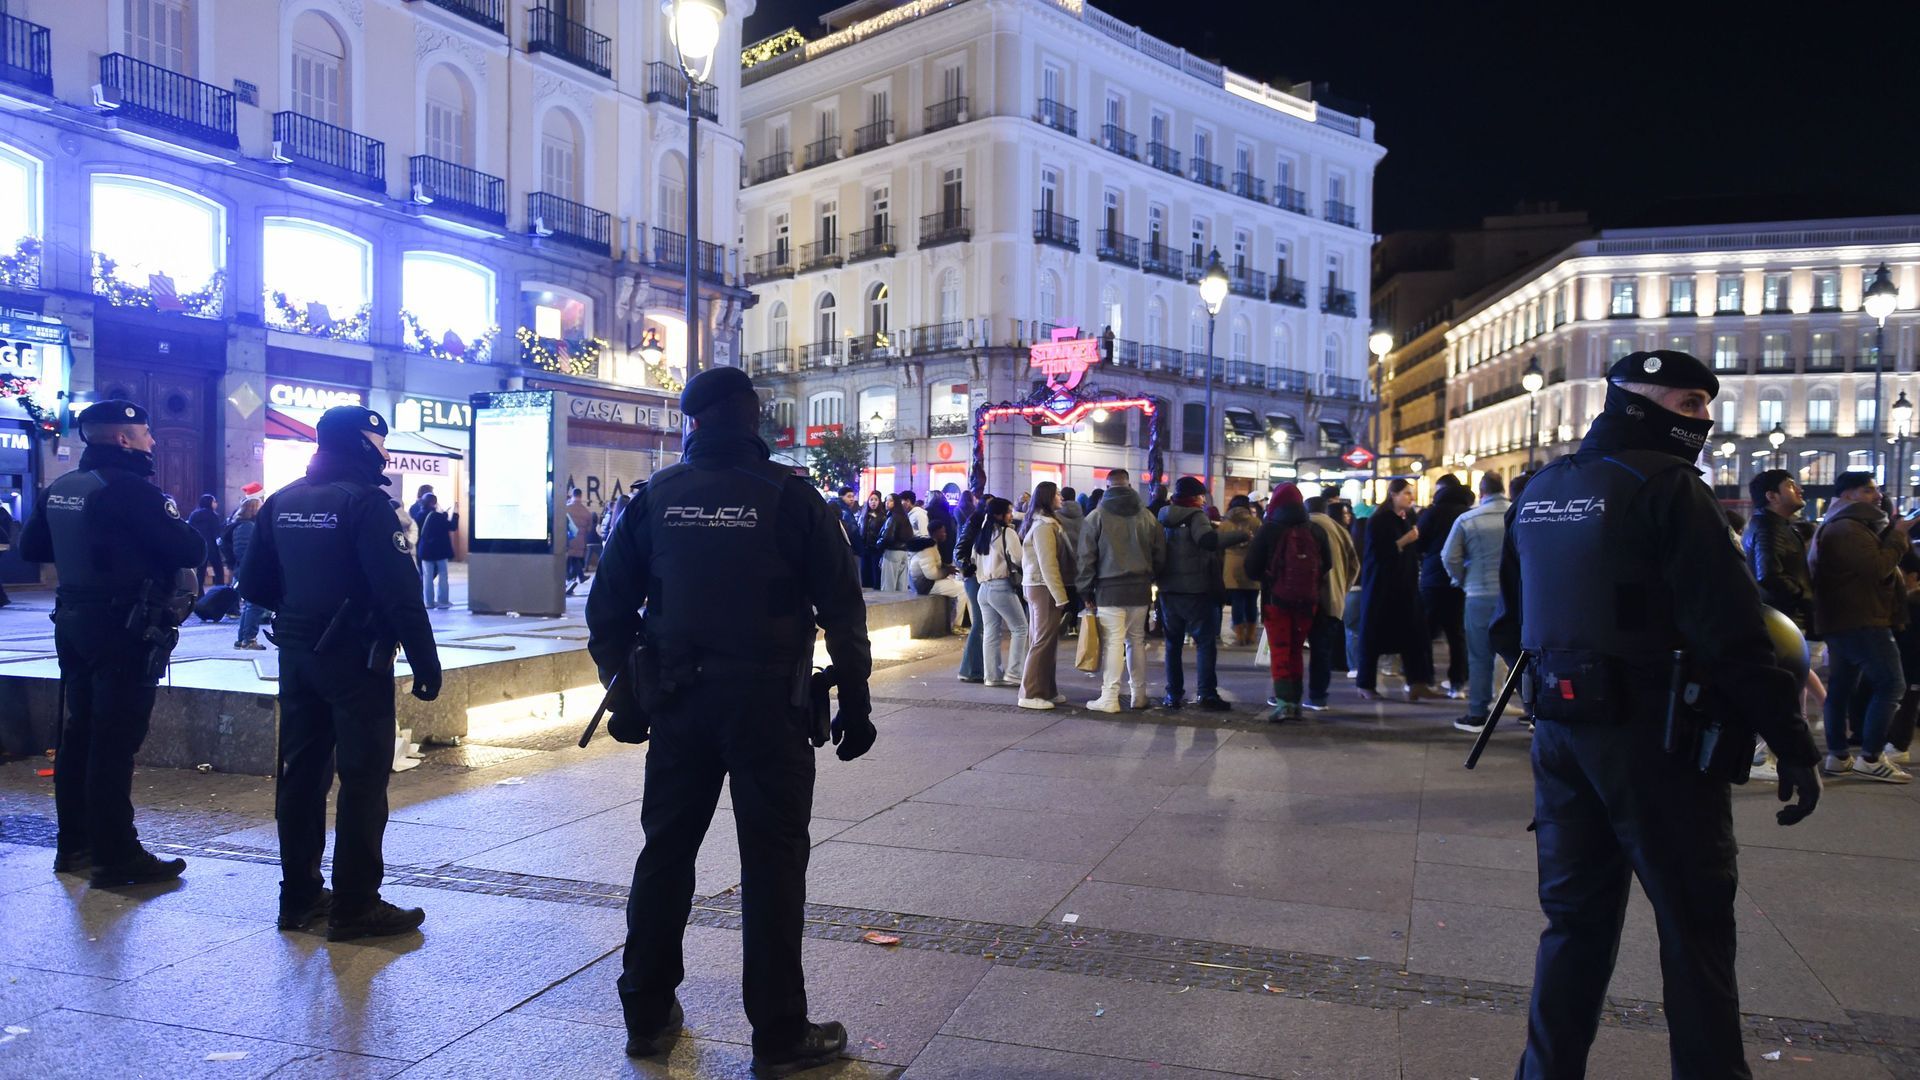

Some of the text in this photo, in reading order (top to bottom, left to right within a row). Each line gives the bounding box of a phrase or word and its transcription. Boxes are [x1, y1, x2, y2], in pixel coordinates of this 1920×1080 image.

[26, 324, 61, 334] WESTERN
[36, 331, 60, 339] UNION
[270, 384, 361, 408] CHANGE
[570, 399, 623, 422] CASA
[635, 406, 660, 426] DE
[387, 457, 440, 472] HANGE
[663, 505, 758, 520] POLICÍA
[1520, 496, 1605, 515] POLICÍA
[277, 511, 338, 523] POLICÍA
